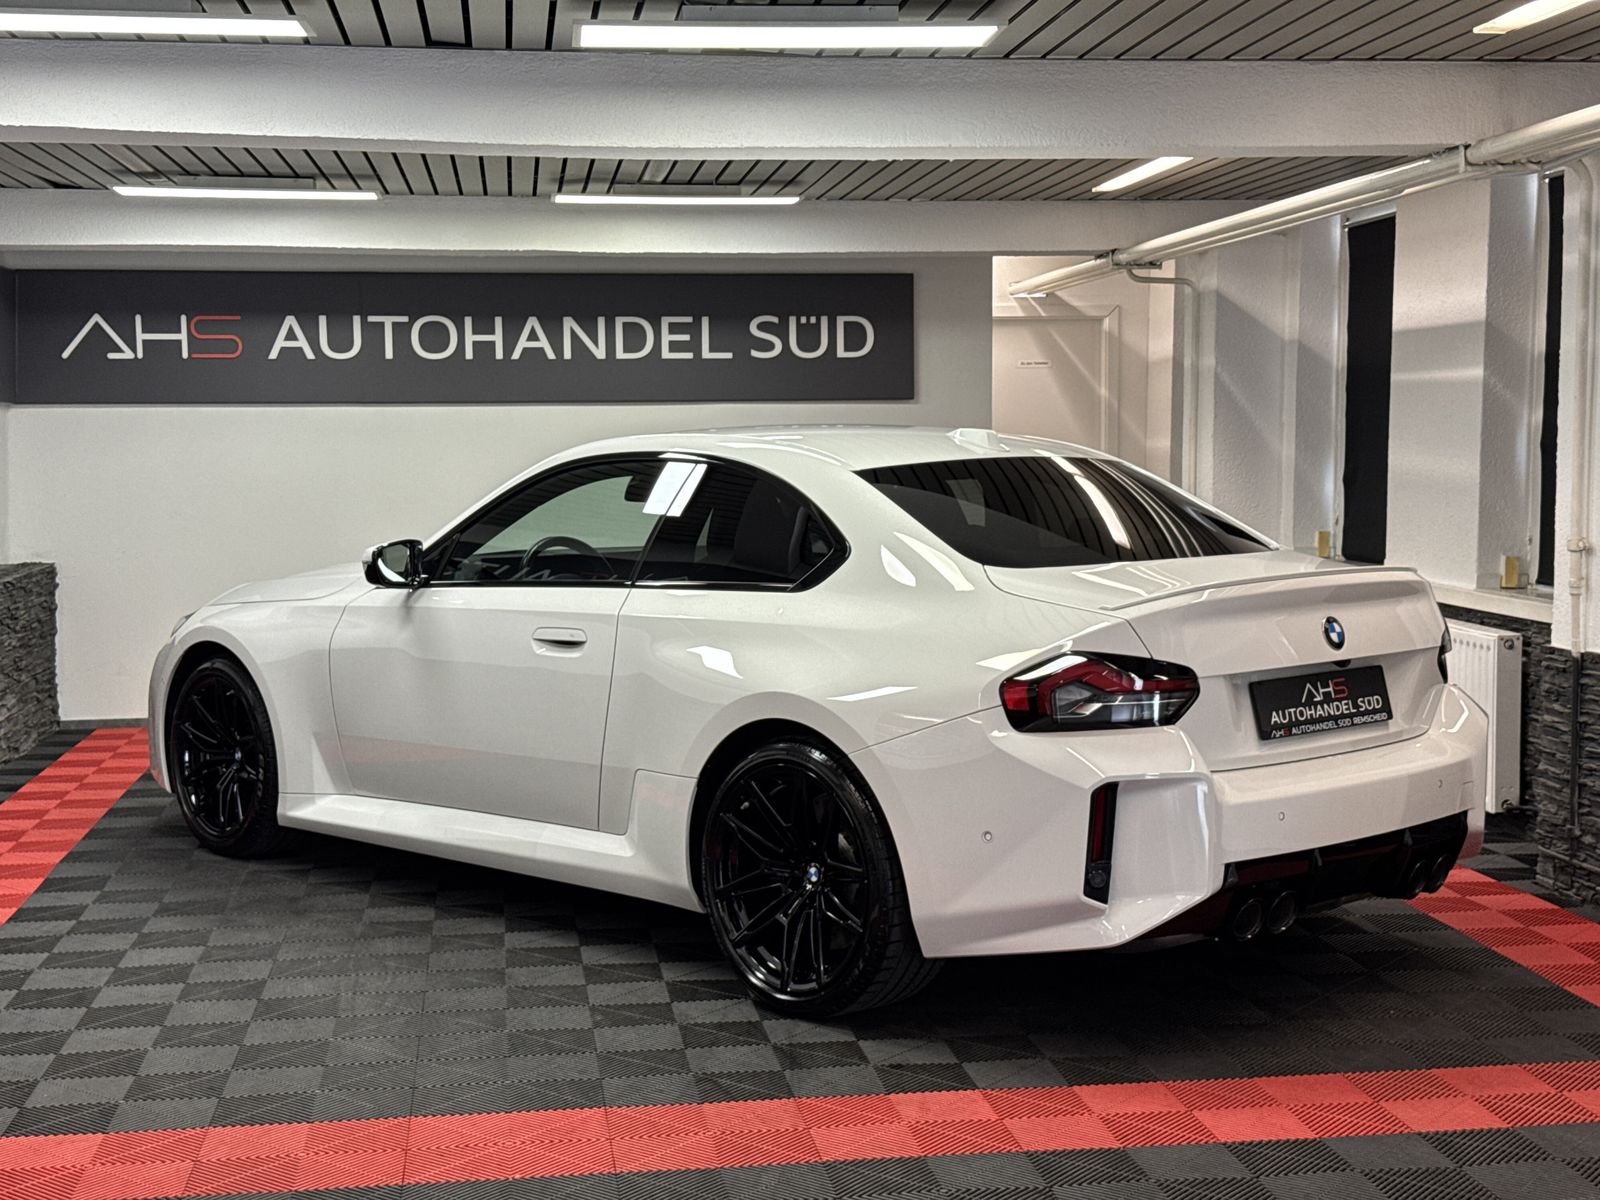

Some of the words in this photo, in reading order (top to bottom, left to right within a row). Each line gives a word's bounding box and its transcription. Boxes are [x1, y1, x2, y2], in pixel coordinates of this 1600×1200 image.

[62, 312, 243, 359] AHS
[268, 314, 733, 360] AUTOHANDEL
[748, 314, 876, 359] SÜD
[1302, 678, 1348, 703] AHS
[1271, 697, 1356, 725] AUTOHANDEL
[1358, 695, 1383, 712] SÜD
[1271, 728, 1291, 738] AHS
[1292, 721, 1337, 735] AUTOHANDEL
